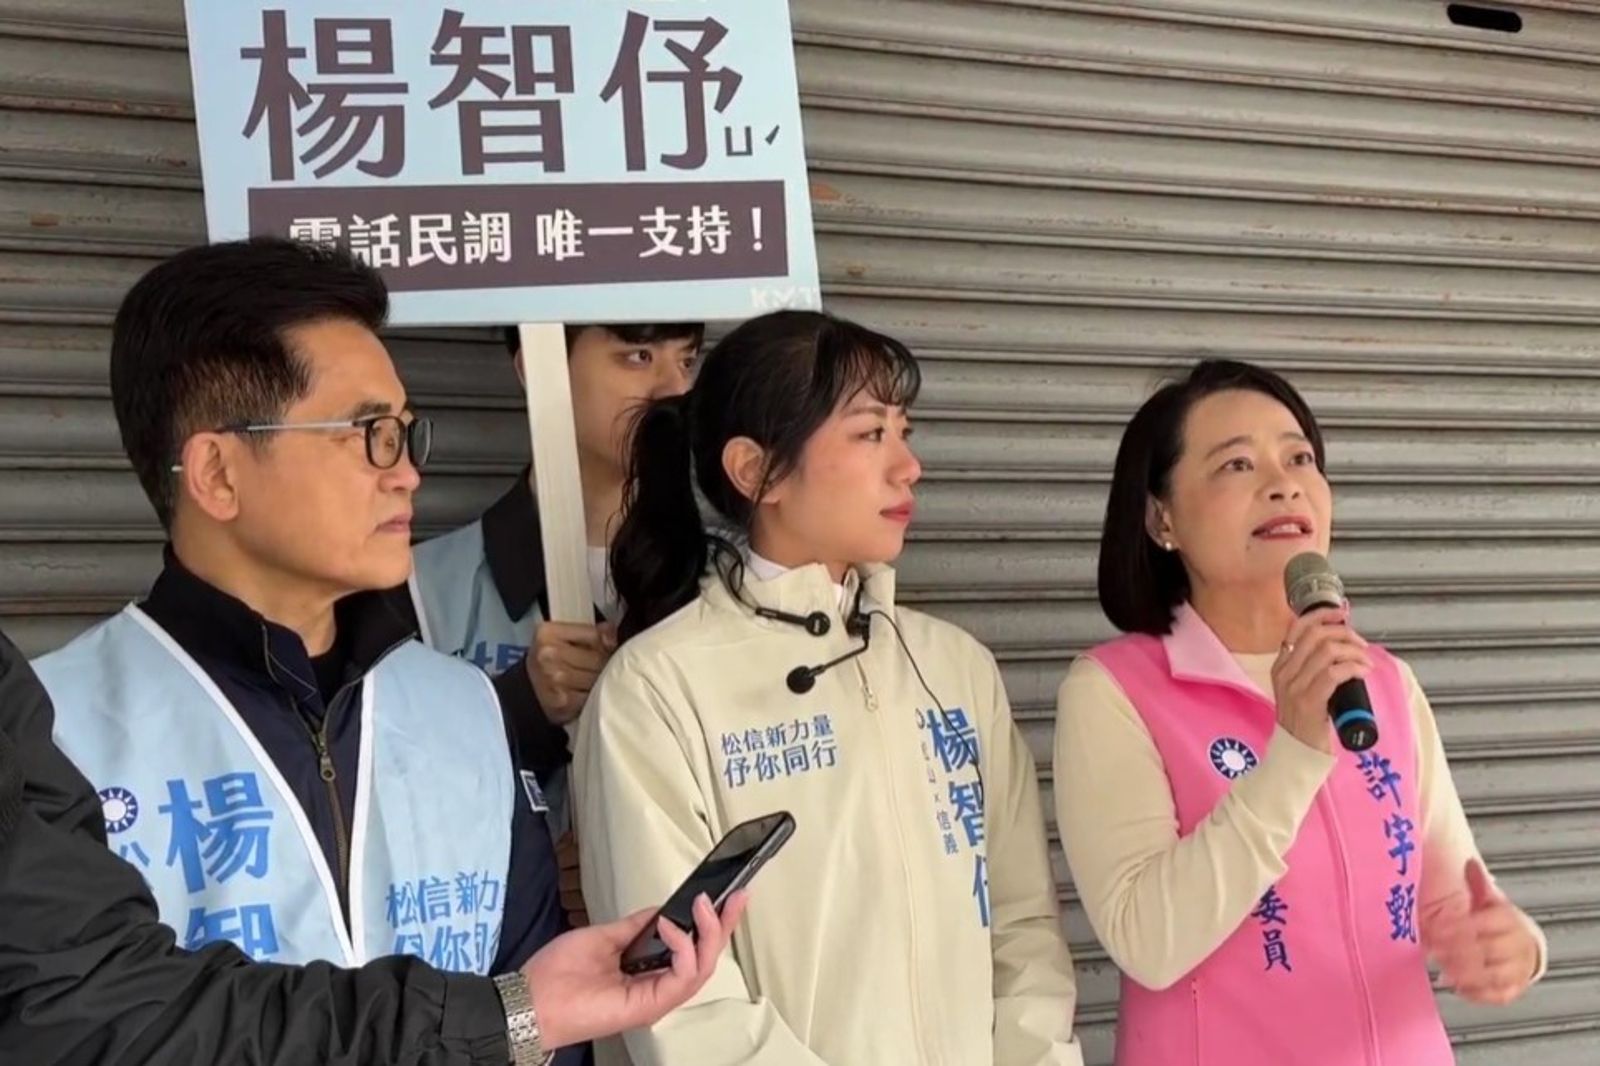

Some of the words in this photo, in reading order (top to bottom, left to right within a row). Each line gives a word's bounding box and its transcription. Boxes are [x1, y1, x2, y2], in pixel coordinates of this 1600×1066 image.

[240, 9, 743, 181] 楊智伃
[721, 713, 834, 755] 松信新力量
[723, 738, 838, 788] 伃你同行
[1355, 751, 1417, 943] 許宇甄
